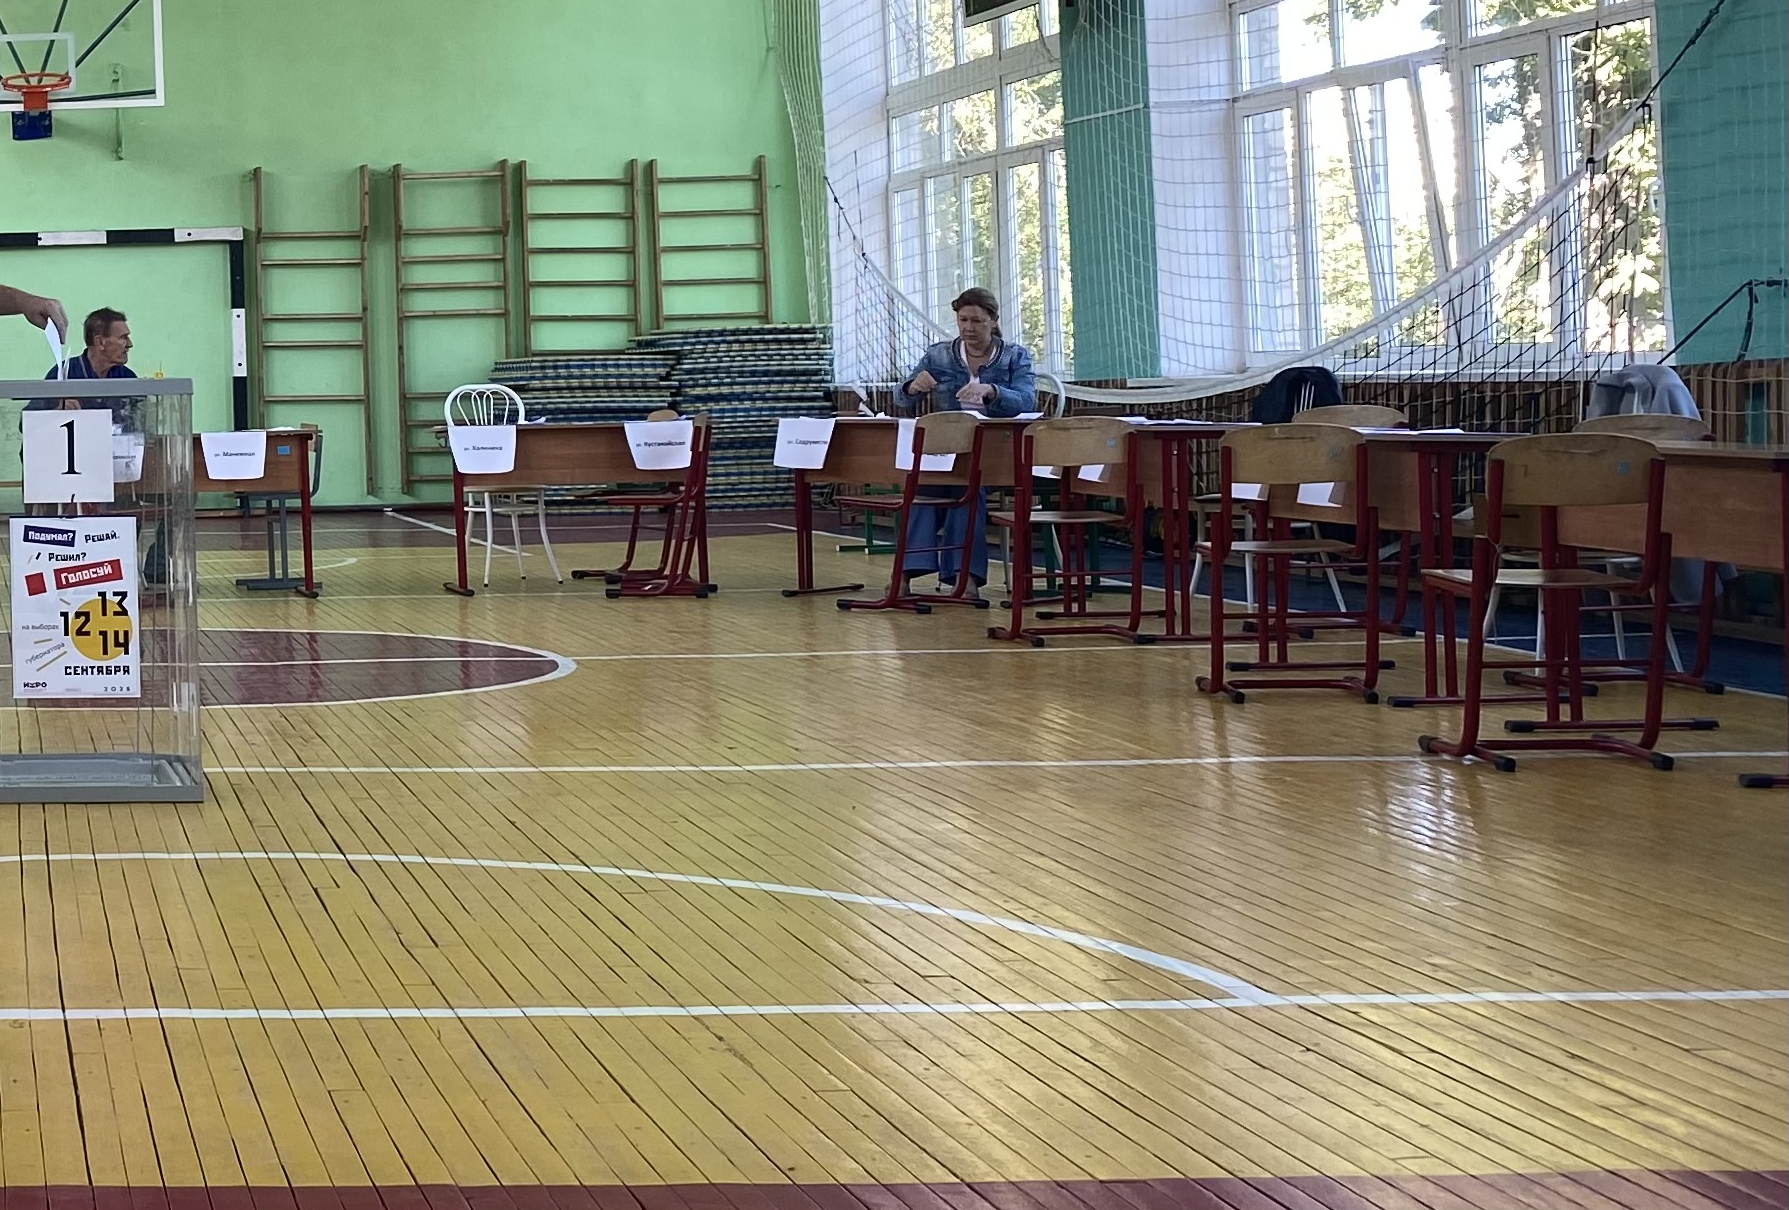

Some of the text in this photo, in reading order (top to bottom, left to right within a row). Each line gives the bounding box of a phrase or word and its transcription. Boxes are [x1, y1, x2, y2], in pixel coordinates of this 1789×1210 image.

[59, 419, 82, 475] 1
[28, 531, 73, 542] Подумал?
[60, 563, 112, 585] Голосуй
[98, 591, 128, 616] 13
[60, 611, 90, 636] 12
[25, 642, 65, 664] губернатора
[99, 630, 129, 655] 14
[64, 665, 130, 676] СЕНТЯБРЯ
